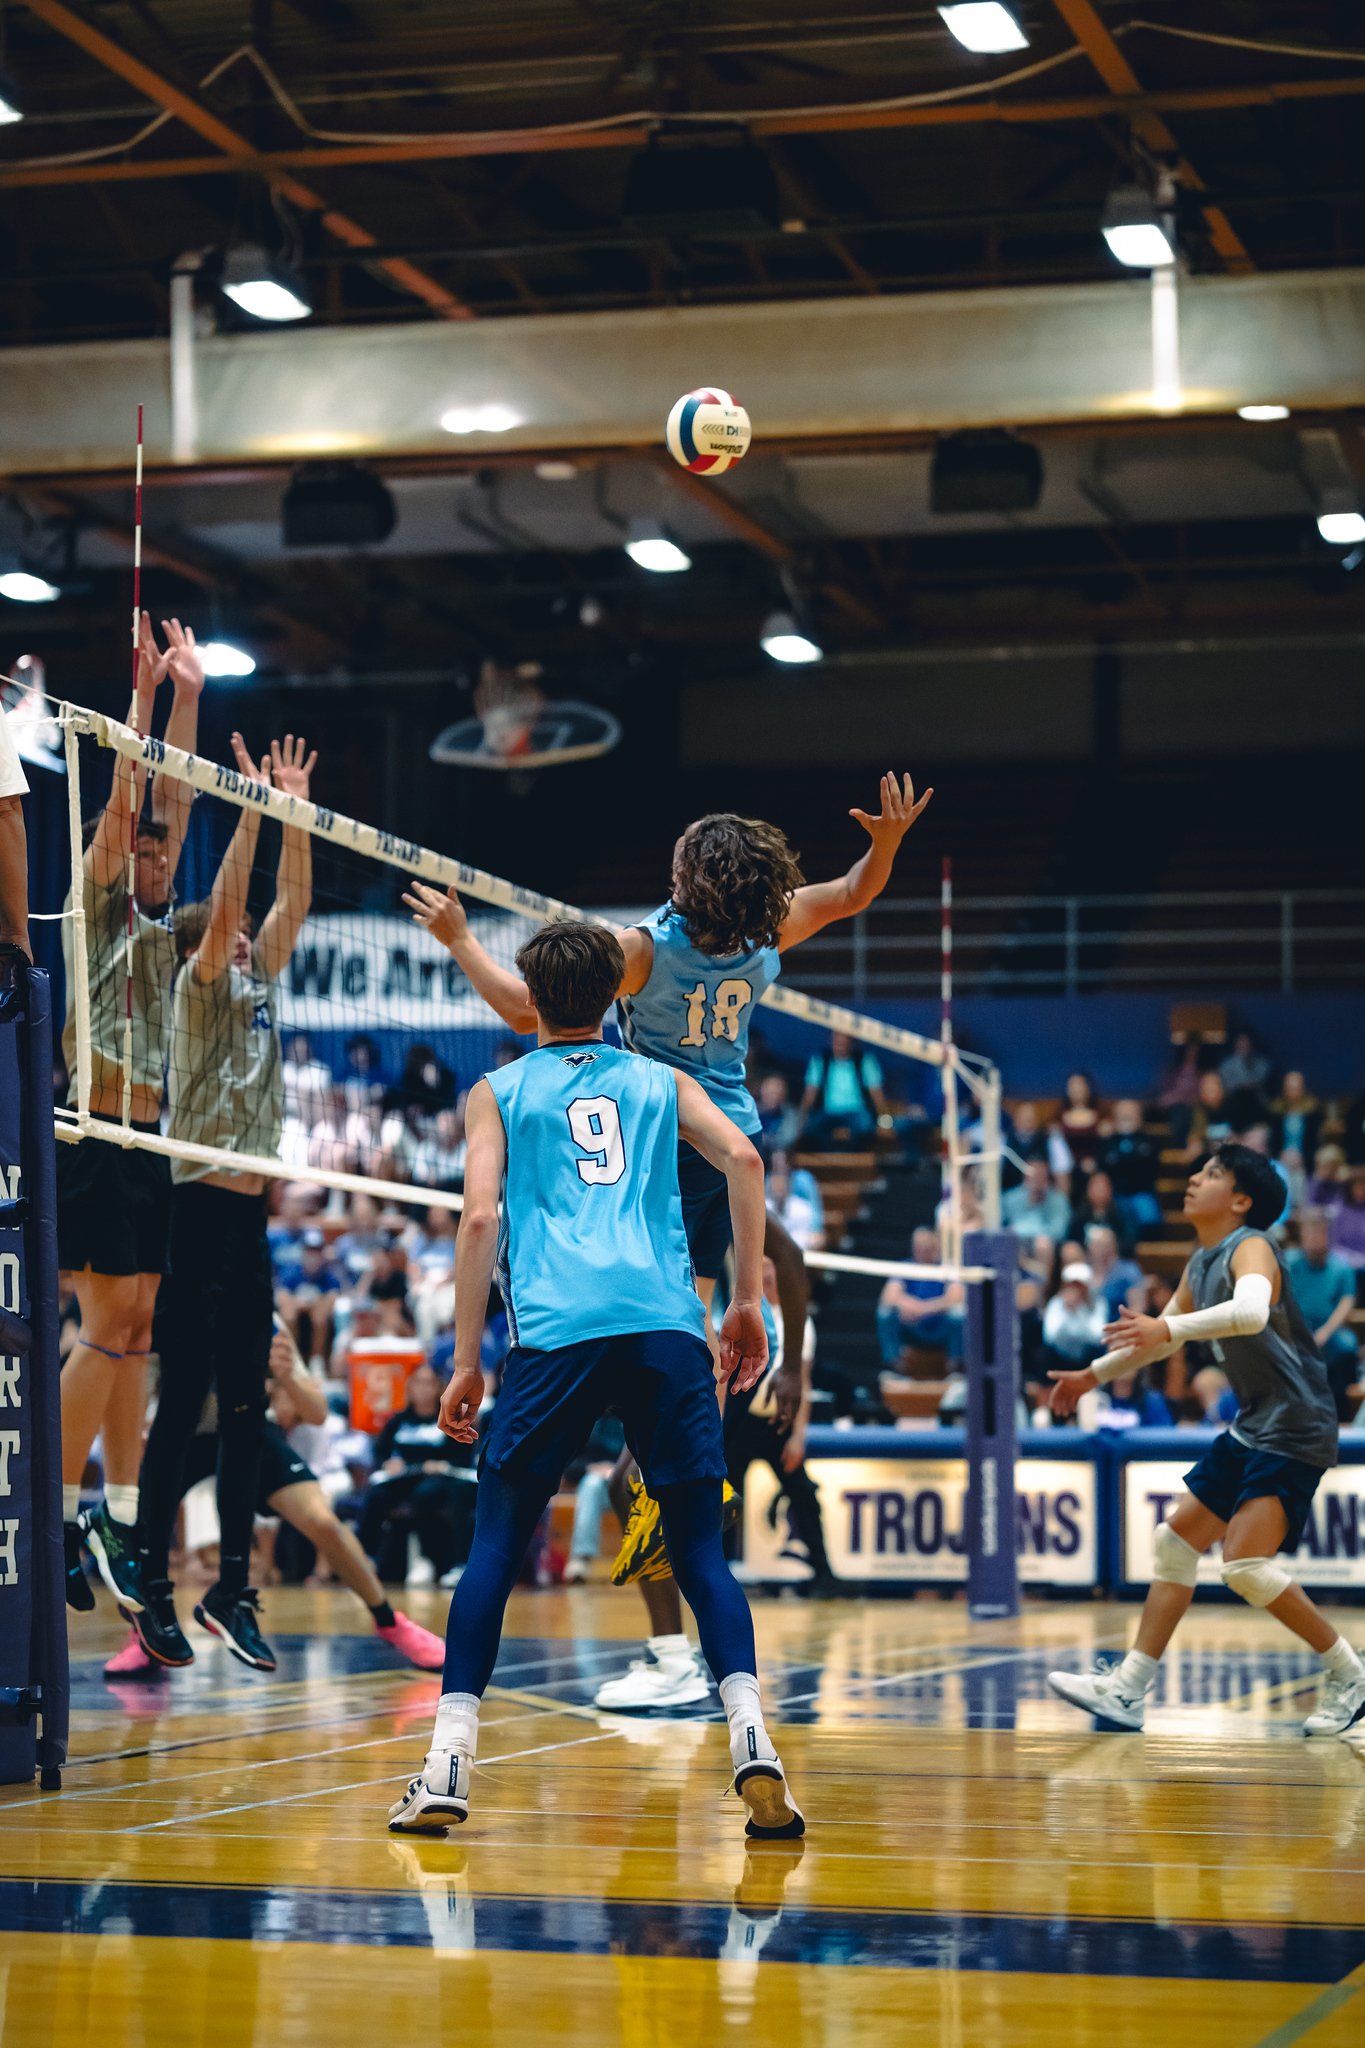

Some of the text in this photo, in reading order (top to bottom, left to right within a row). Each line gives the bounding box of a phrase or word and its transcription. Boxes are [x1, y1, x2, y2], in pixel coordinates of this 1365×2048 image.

[290, 946, 366, 997] We
[678, 978, 754, 1048] 18
[566, 1094, 627, 1186] 9
[844, 1491, 1081, 1556] TROJNS
